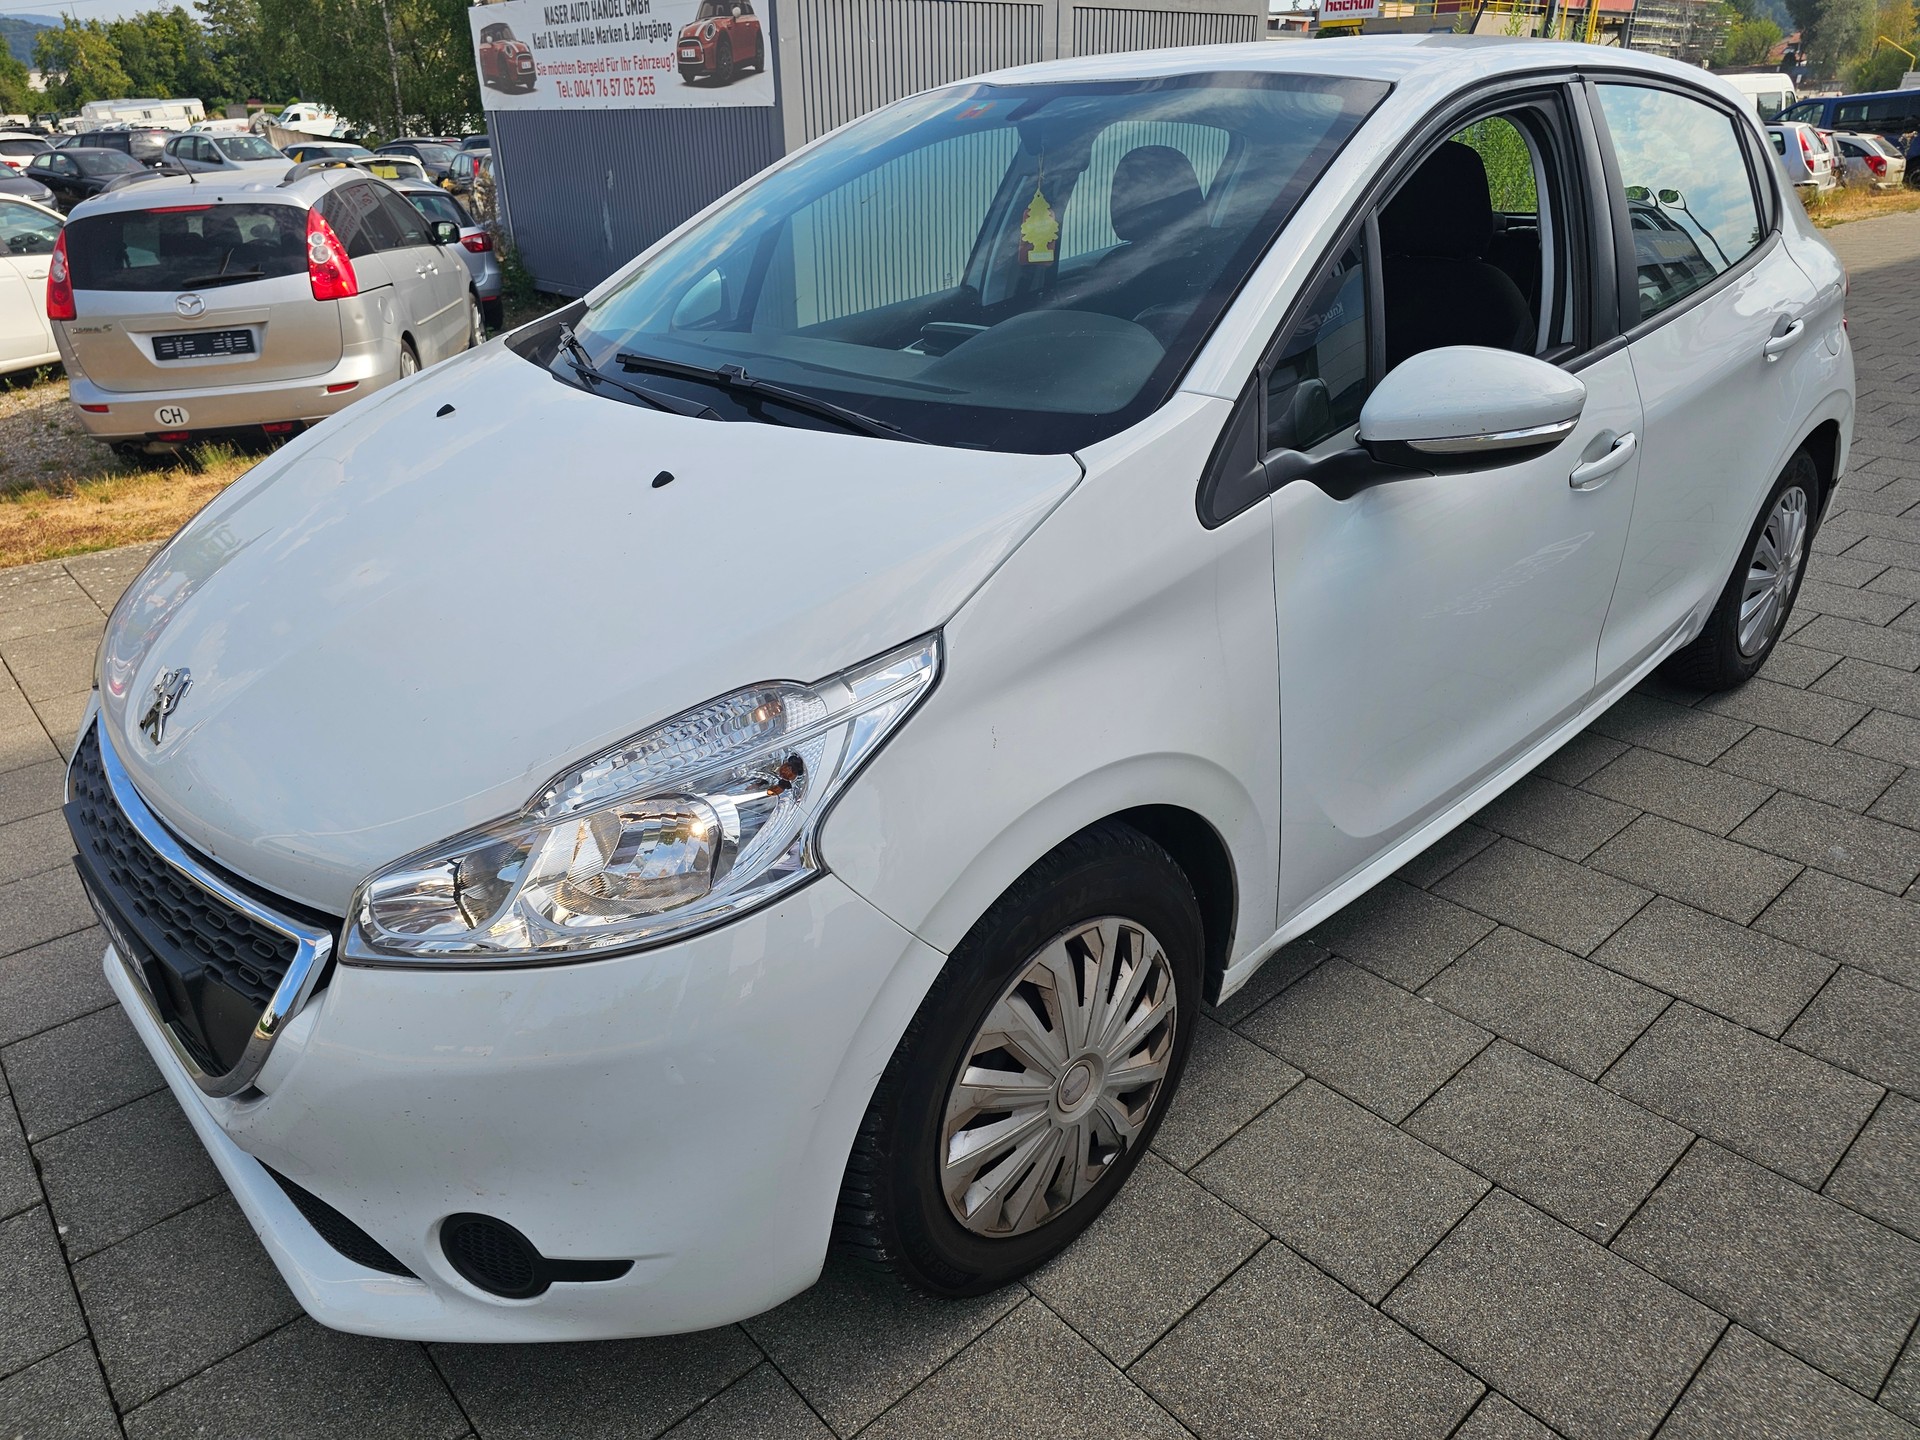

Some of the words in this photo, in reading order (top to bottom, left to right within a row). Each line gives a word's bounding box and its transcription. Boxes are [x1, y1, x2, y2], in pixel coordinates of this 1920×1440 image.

[544, 4, 570, 26] NASER
[570, 1, 590, 23] AUTO
[591, 0, 624, 20] HANDEL
[624, 0, 651, 15] GMBH
[532, 30, 549, 50] Kauf
[548, 31, 554, 48] &
[553, 29, 581, 49] Verkauf
[580, 26, 595, 46] Alle
[595, 23, 624, 45] Marken
[623, 23, 630, 42] &
[631, 19, 673, 44] Jahrgänge
[536, 62, 547, 76] Sie
[548, 59, 577, 76] möchten
[576, 57, 605, 77] Bargeld
[606, 56, 619, 73] Für
[620, 55, 632, 71] Ihr
[633, 52, 676, 73] Fahrzeug?
[556, 80, 574, 98] Tel:
[573, 79, 595, 98] 0041
[596, 78, 609, 97] 76
[609, 77, 621, 97] 57
[623, 77, 636, 96] 05
[636, 76, 656, 96] 255
[159, 408, 184, 425] CH
